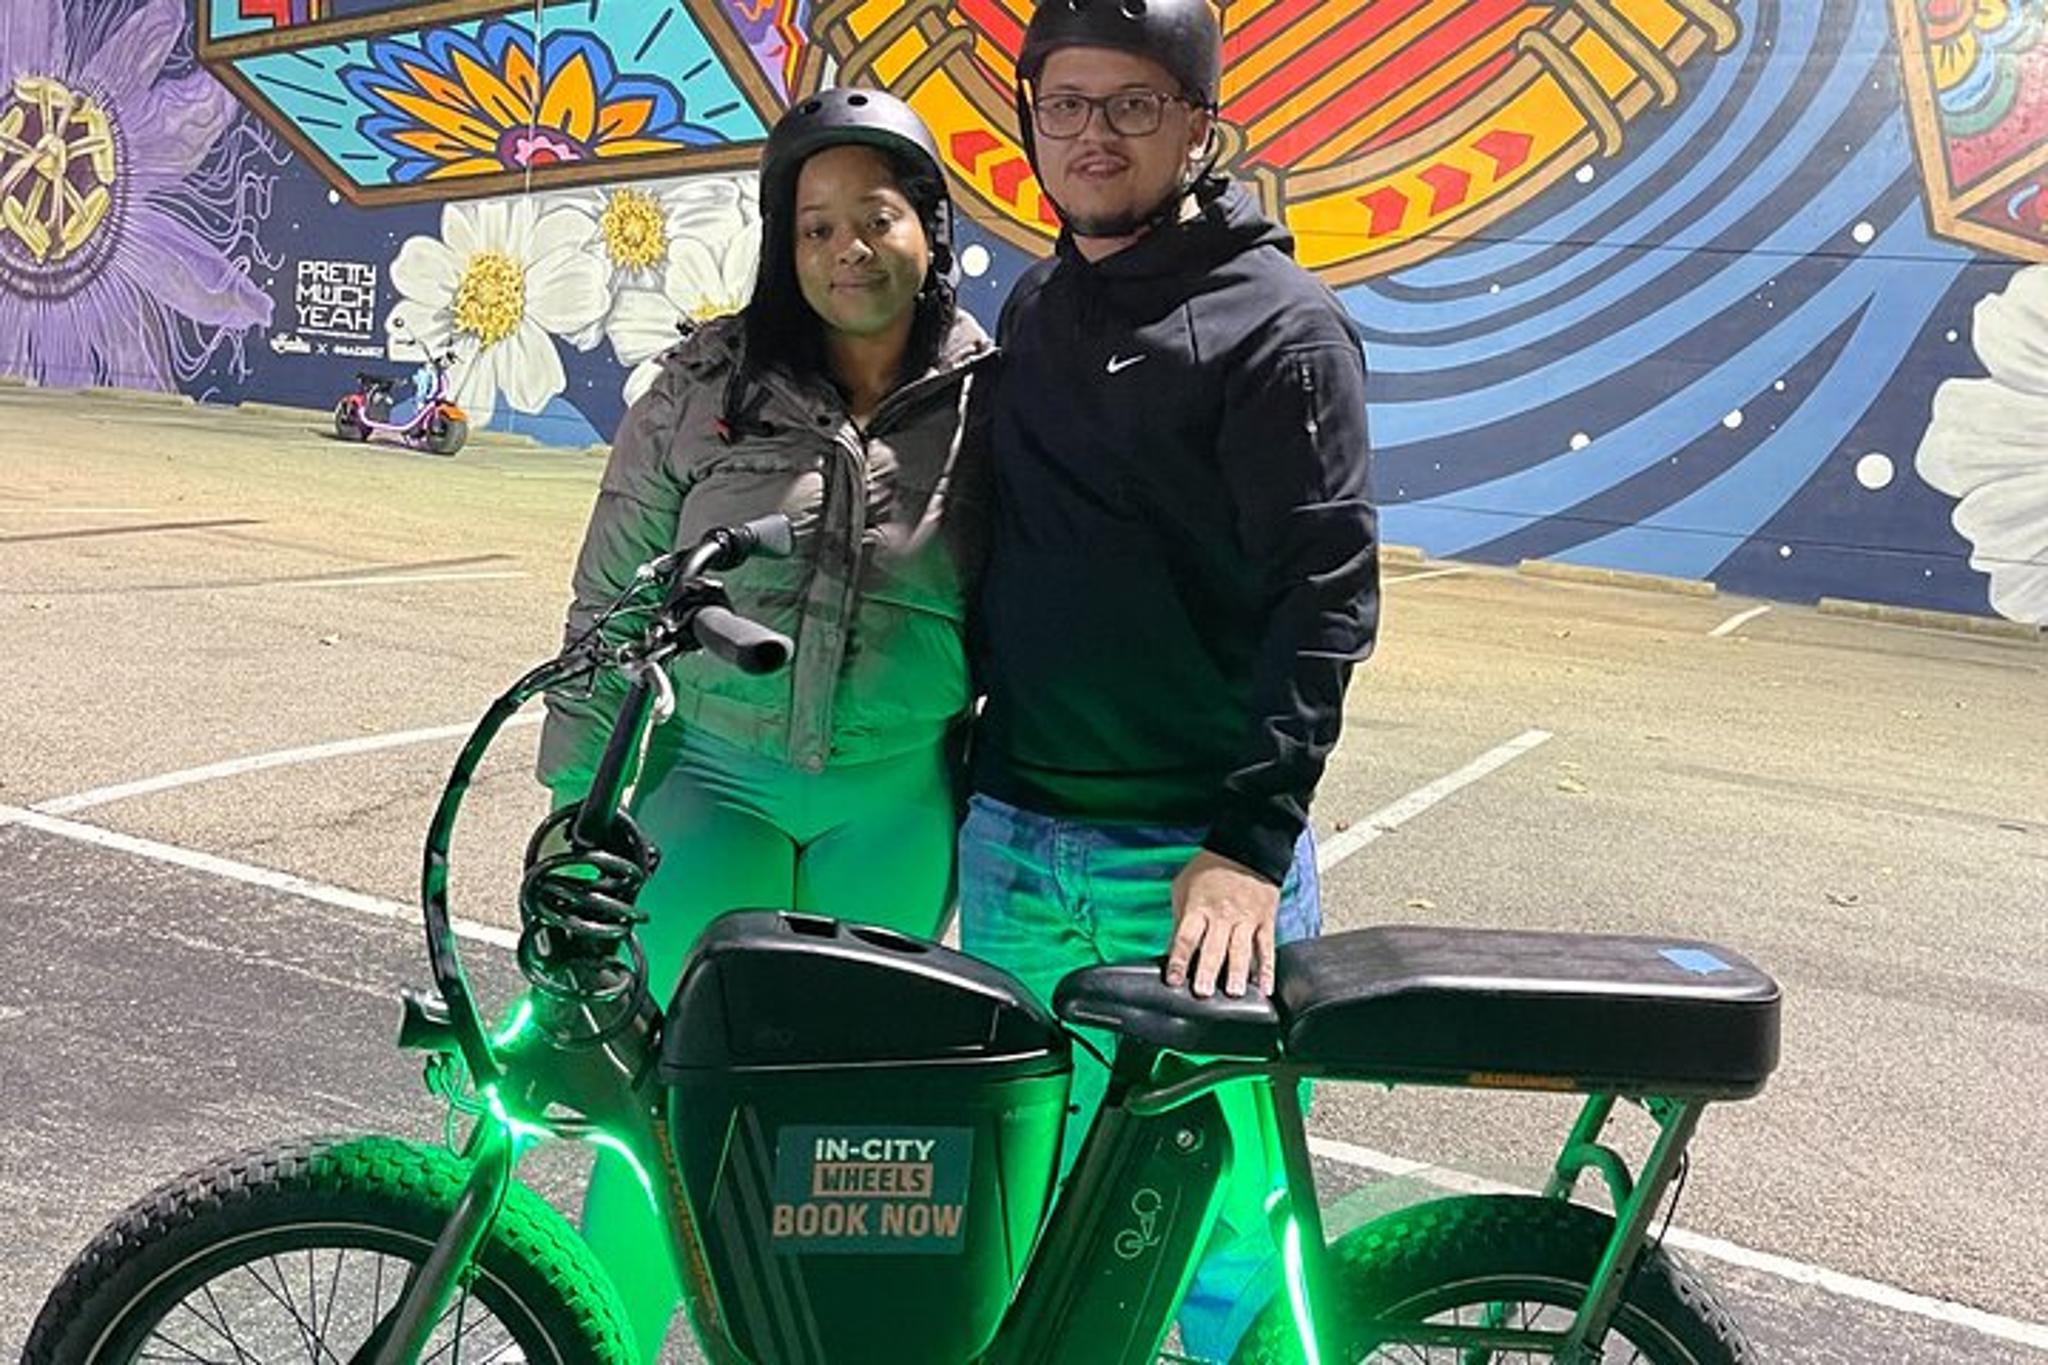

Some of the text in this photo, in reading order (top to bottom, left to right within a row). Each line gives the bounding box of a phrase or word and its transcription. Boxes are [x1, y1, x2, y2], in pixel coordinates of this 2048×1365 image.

[298, 261, 376, 286] PRETTY
[296, 282, 375, 308] MUCH
[295, 304, 373, 331] YEAH
[814, 1138, 936, 1161] IN-CITY
[821, 1167, 926, 1192] WHEELS
[772, 1203, 964, 1238] BOOK NOW
